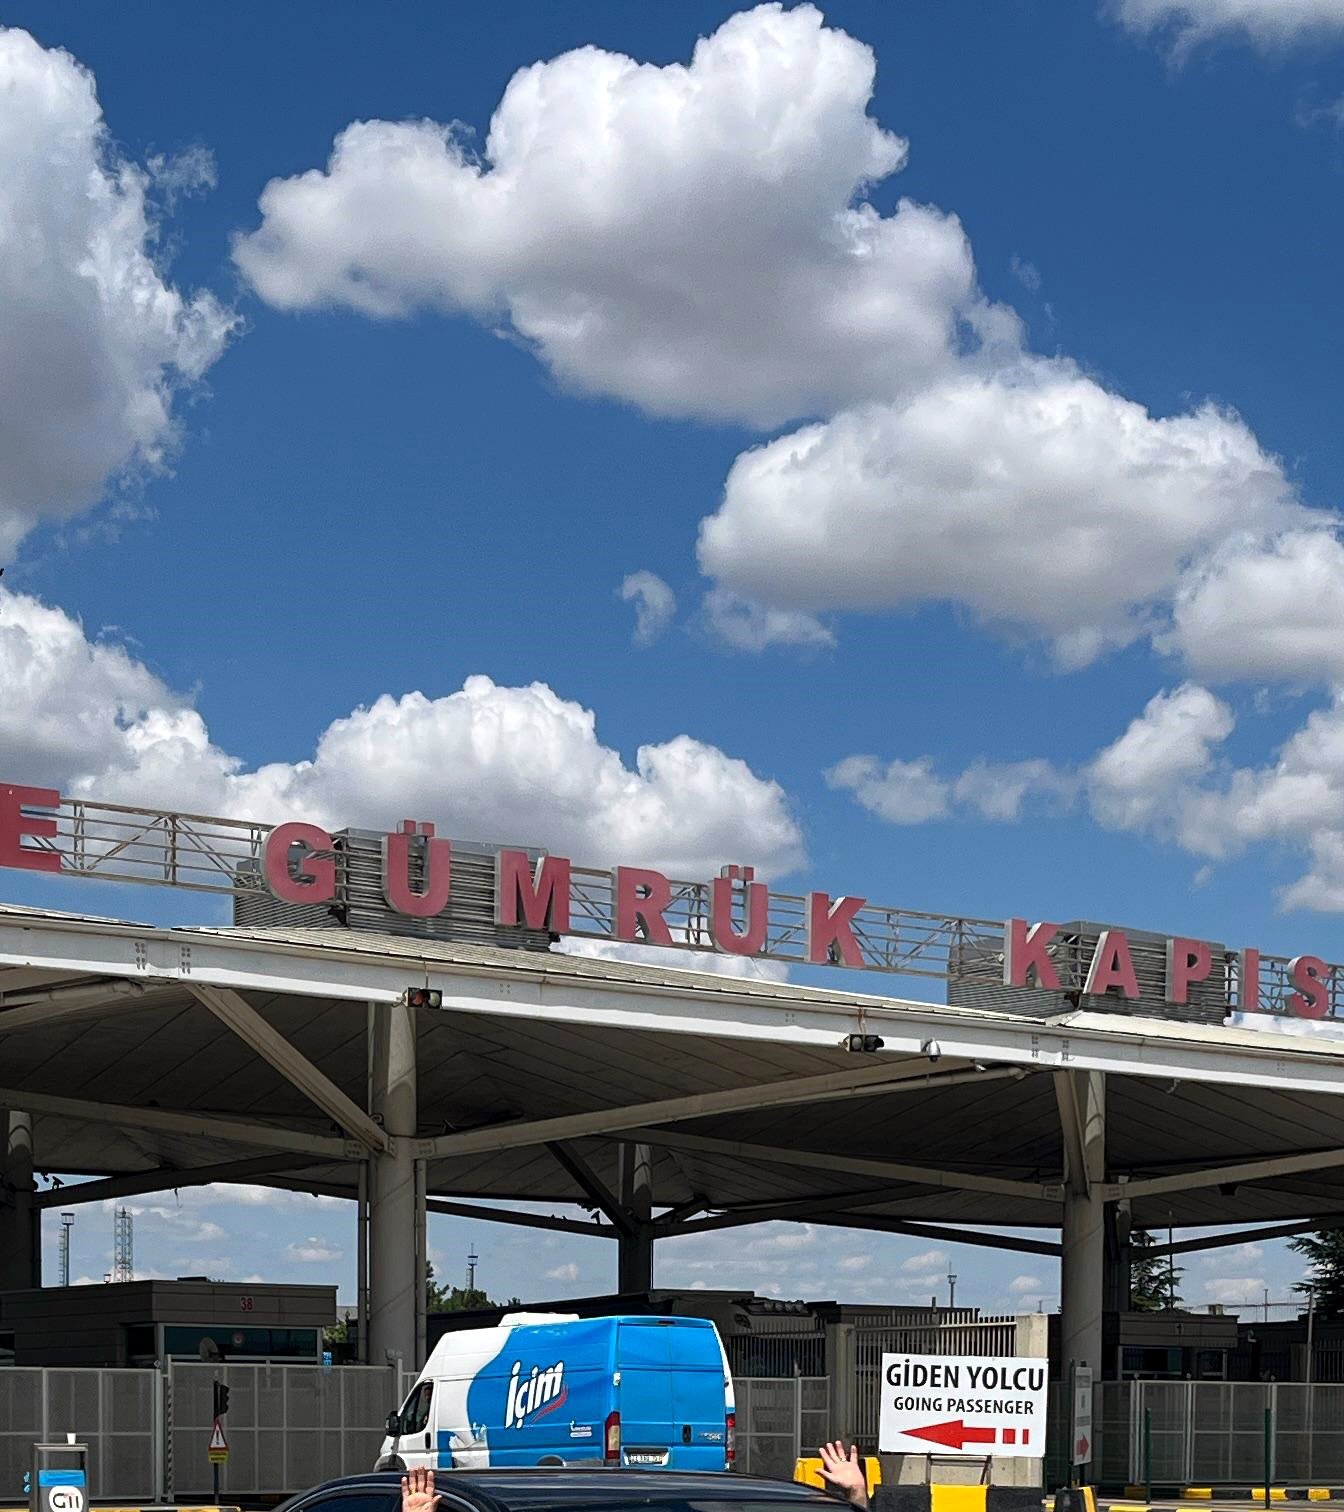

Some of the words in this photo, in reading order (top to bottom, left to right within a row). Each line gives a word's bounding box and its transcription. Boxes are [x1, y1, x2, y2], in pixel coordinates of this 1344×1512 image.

[260, 819, 867, 969] GÜMRÜK
[240, 1297, 253, 1311] 38
[886, 1359, 959, 1389] GİDEN
[967, 1365, 1044, 1392] YOLCU
[894, 1396, 943, 1412] GOING
[947, 1398, 1035, 1415] PASSENGER
